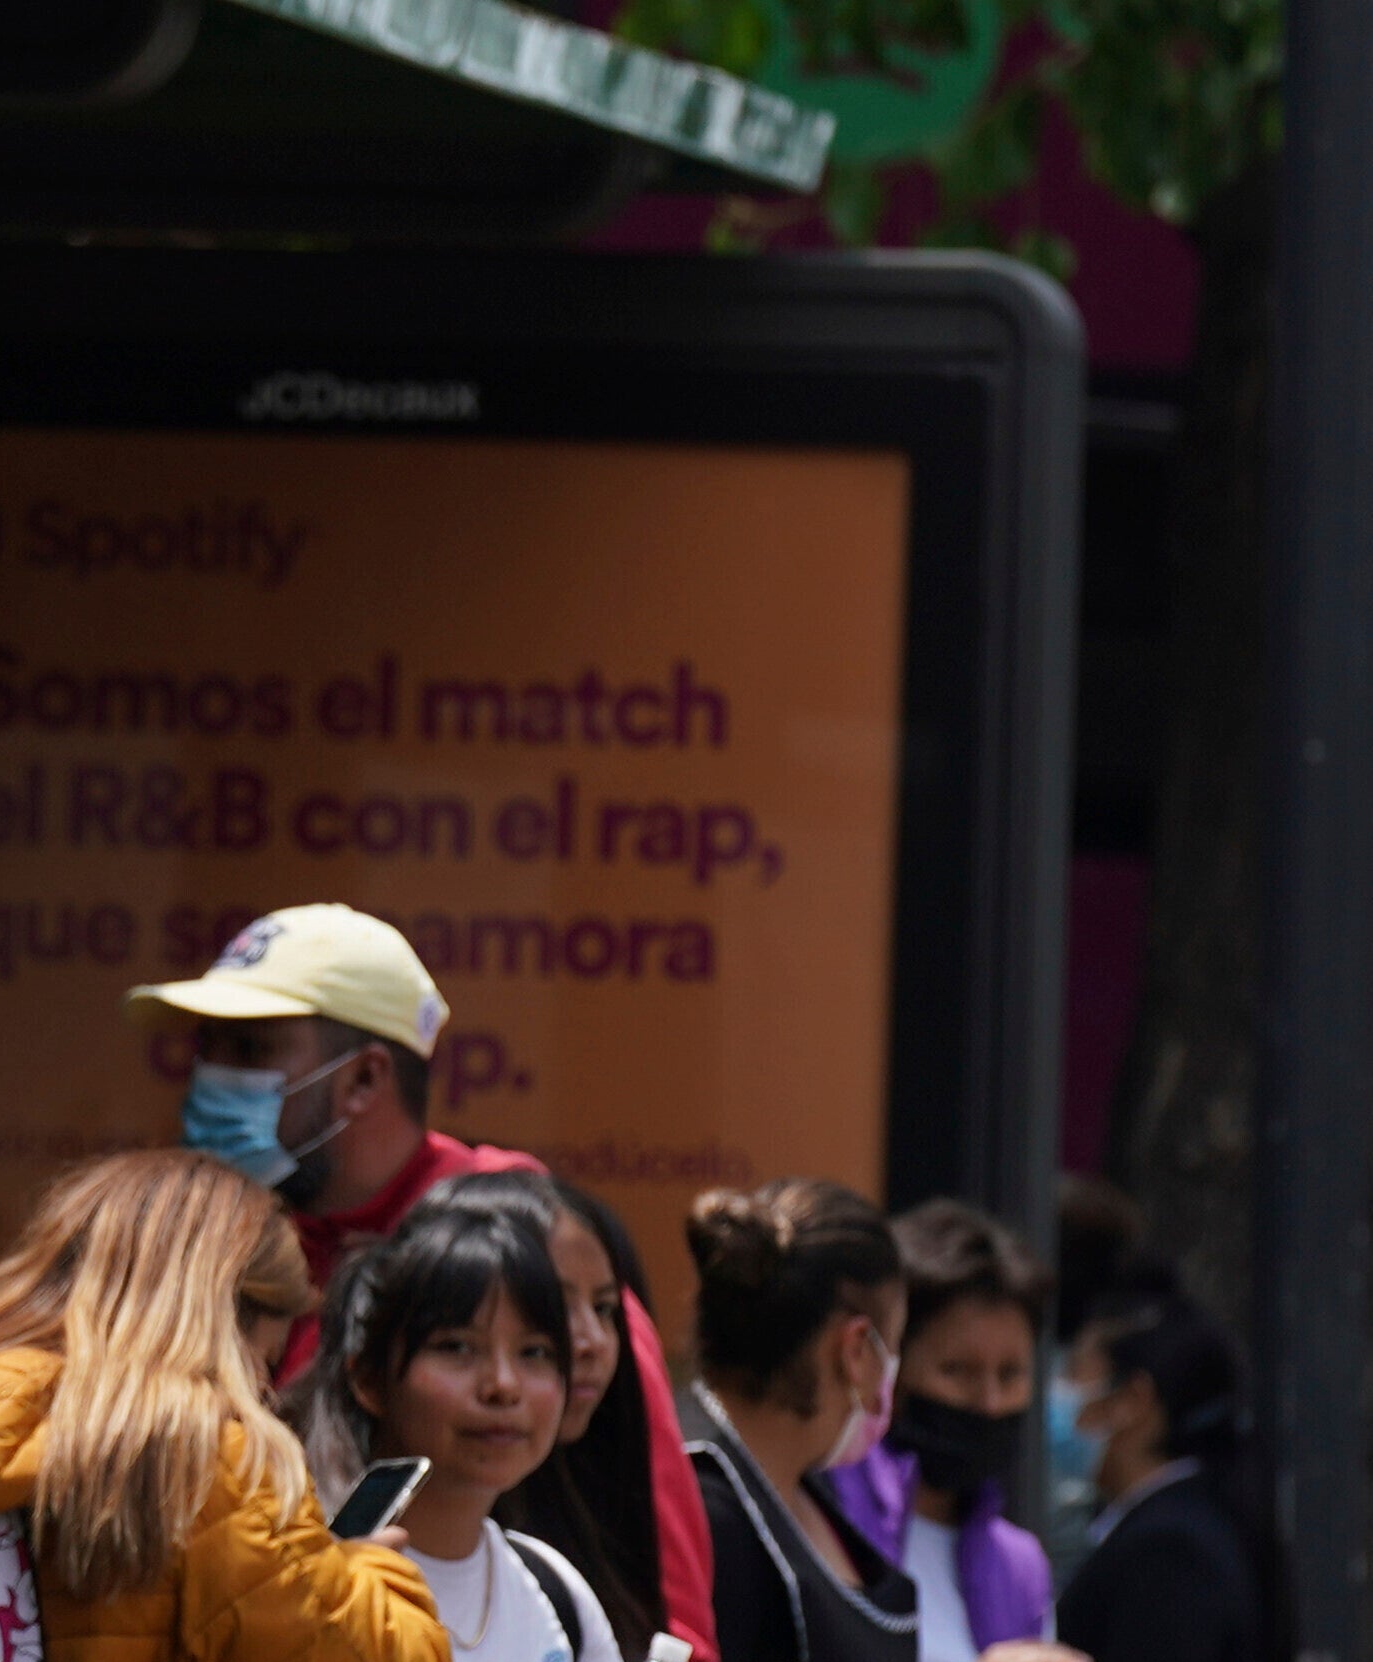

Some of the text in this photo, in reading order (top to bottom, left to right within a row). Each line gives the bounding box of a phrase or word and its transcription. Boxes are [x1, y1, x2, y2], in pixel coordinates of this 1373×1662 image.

[22, 499, 305, 588] Spotify
[318, 654, 397, 741] el
[420, 660, 729, 748] match
[67, 764, 270, 852] R&B
[293, 793, 472, 860] con
[495, 776, 576, 862] el
[599, 797, 785, 887] rap,
